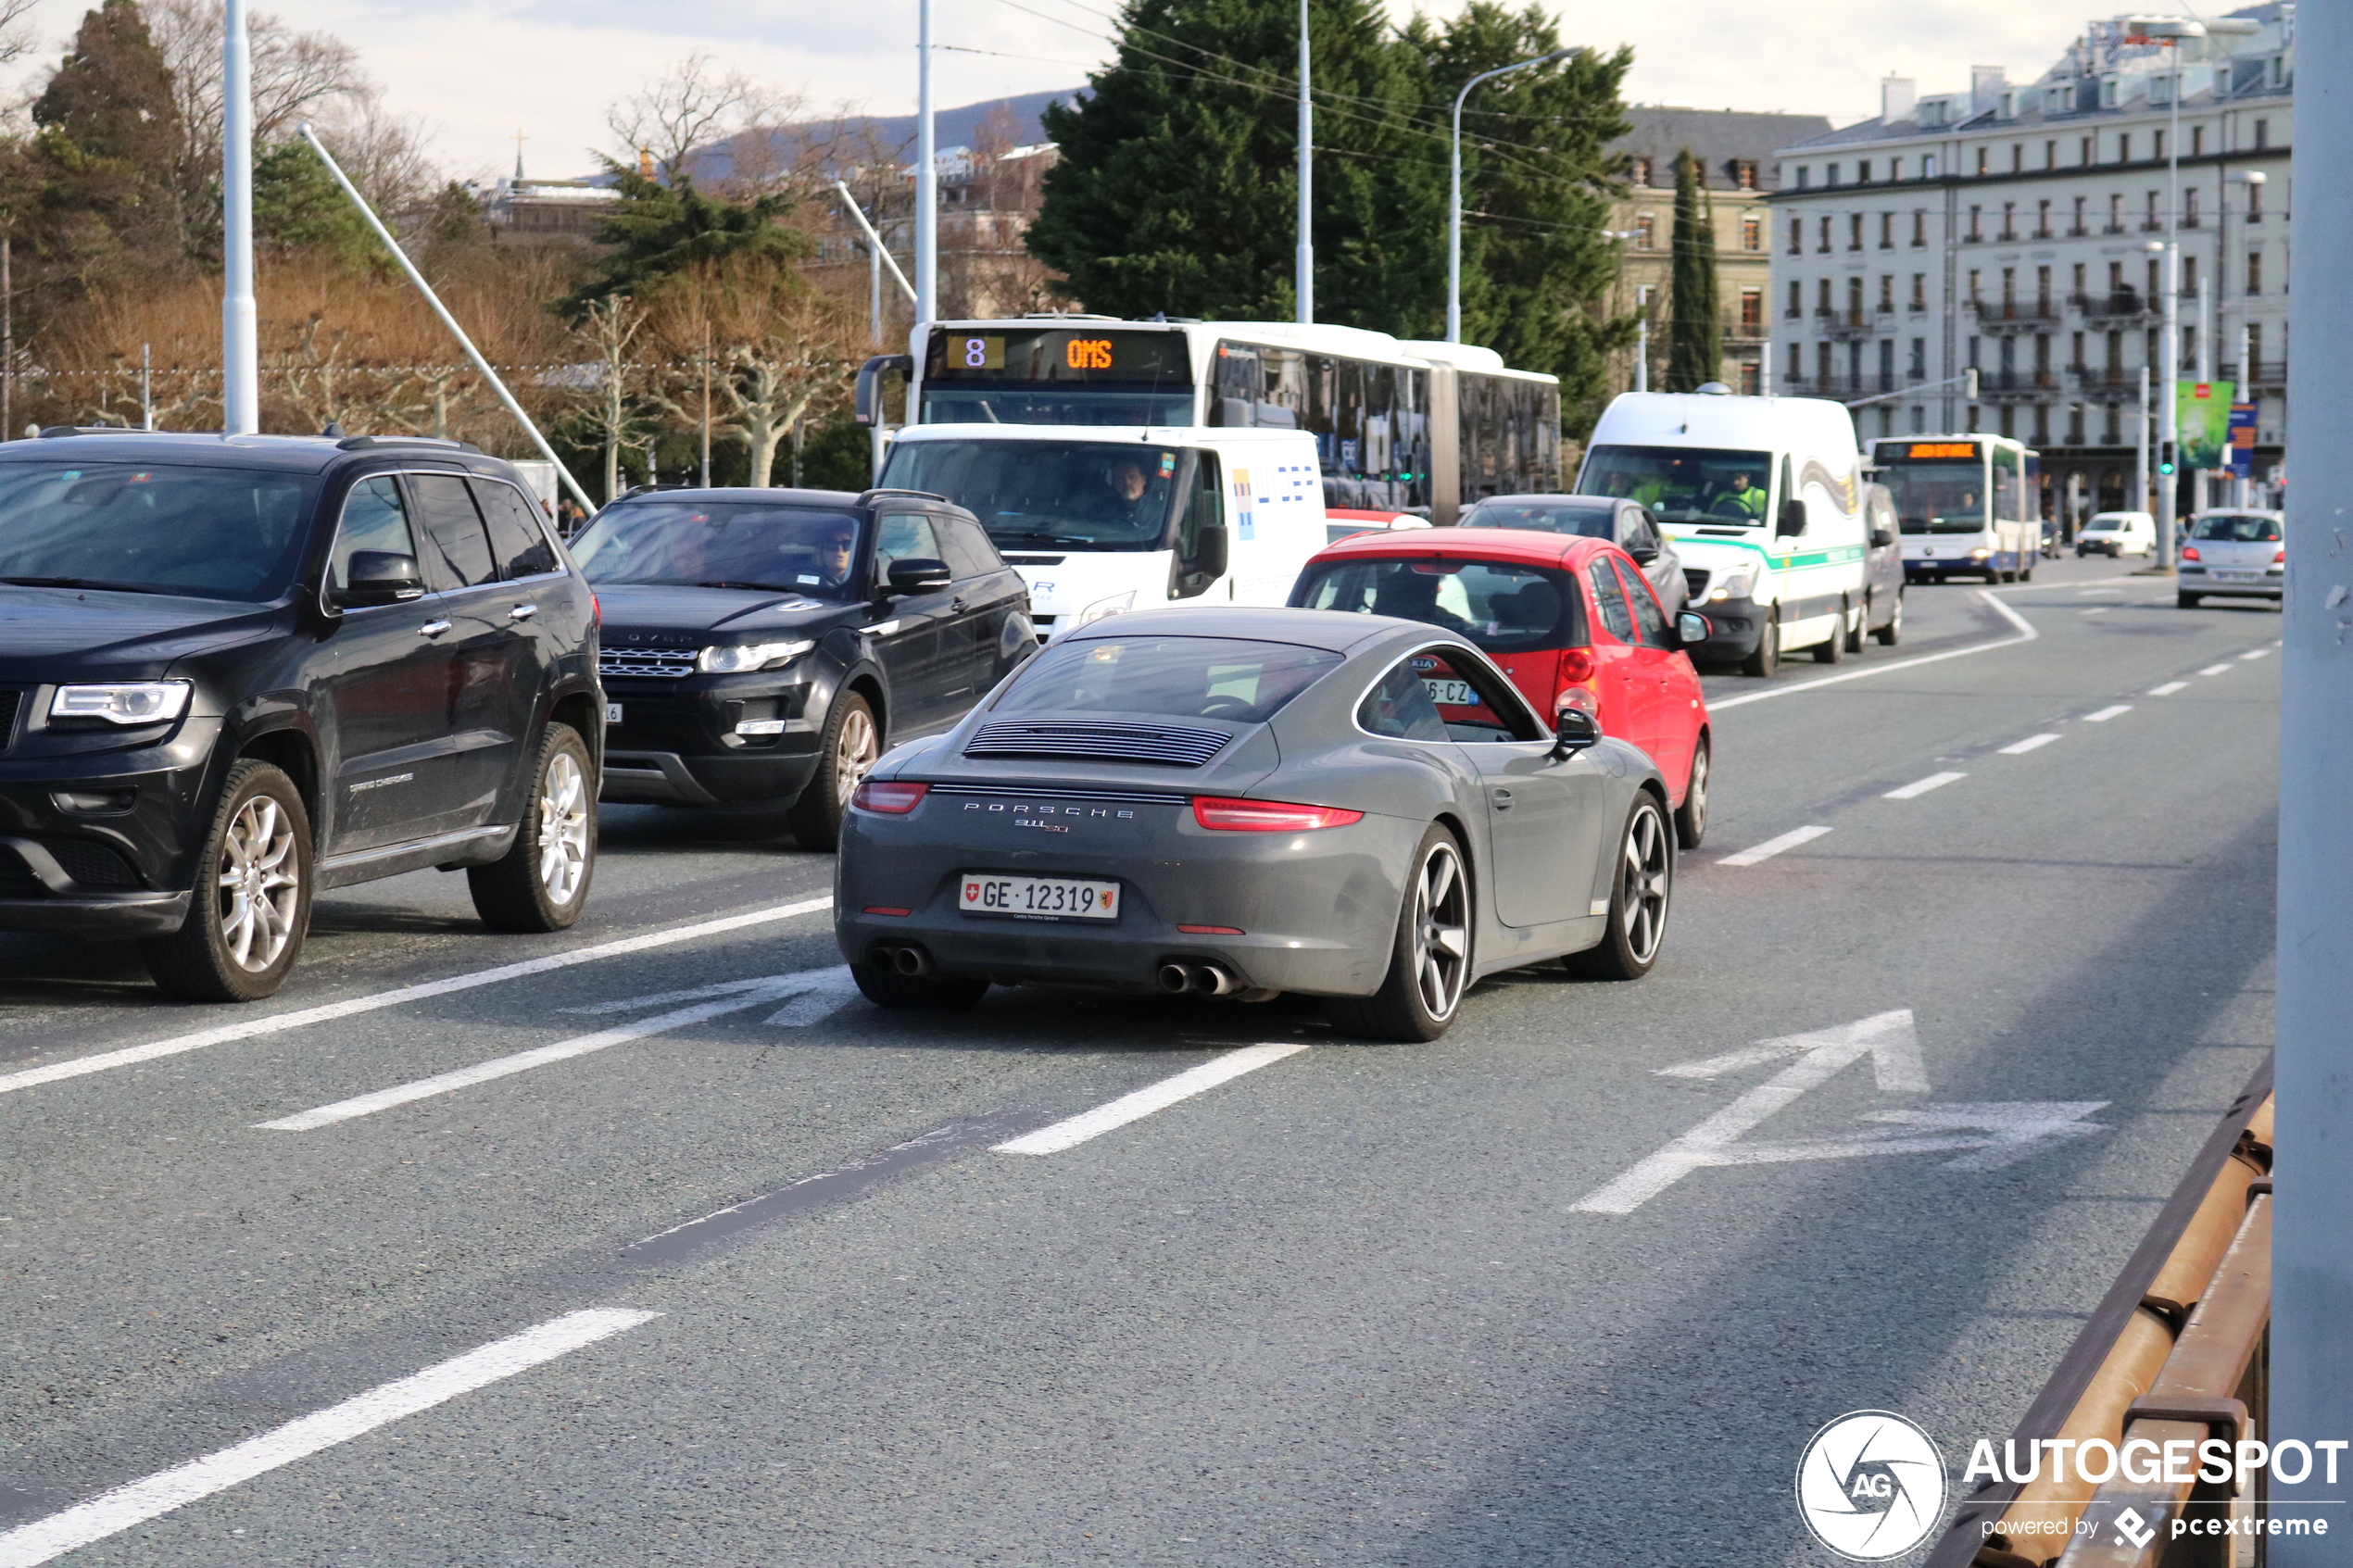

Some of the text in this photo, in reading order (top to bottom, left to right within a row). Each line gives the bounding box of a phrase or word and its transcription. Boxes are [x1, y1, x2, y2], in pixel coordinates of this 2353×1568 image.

[964, 338, 986, 367] 8
[1067, 339, 1113, 369] OMS
[1412, 659, 1432, 668] KIA
[964, 803, 1134, 819] PORSCHE
